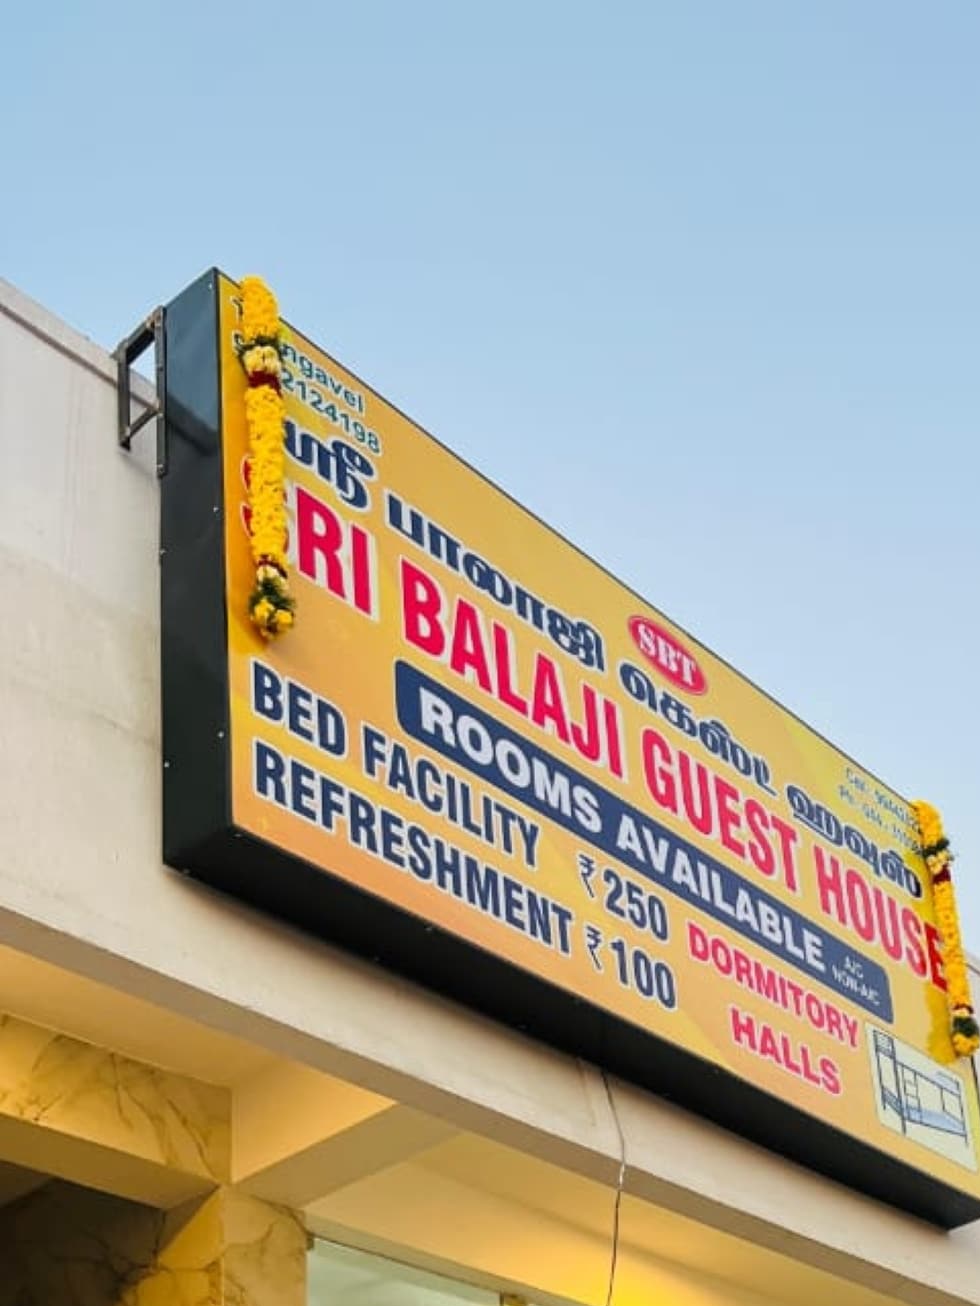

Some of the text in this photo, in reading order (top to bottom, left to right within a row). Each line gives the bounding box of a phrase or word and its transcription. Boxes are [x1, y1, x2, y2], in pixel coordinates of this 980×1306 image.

[234, 333, 380, 454] 2124198
[242, 455, 371, 615] RI
[401, 558, 623, 780] BALAJI
[642, 728, 797, 893] GUEST
[813, 845, 948, 993] HOUSE
[388, 493, 604, 672] பாலாஜி
[637, 622, 697, 687] SBT
[253, 662, 346, 757] BED
[364, 726, 541, 867] FACILITY
[688, 922, 859, 1048] DORMITORY
[254, 742, 573, 954] REFRESHMENT
[730, 1006, 840, 1094] HALLS
[419, 687, 602, 833] ROOMS
[615, 815, 826, 973] AVAILABLE
